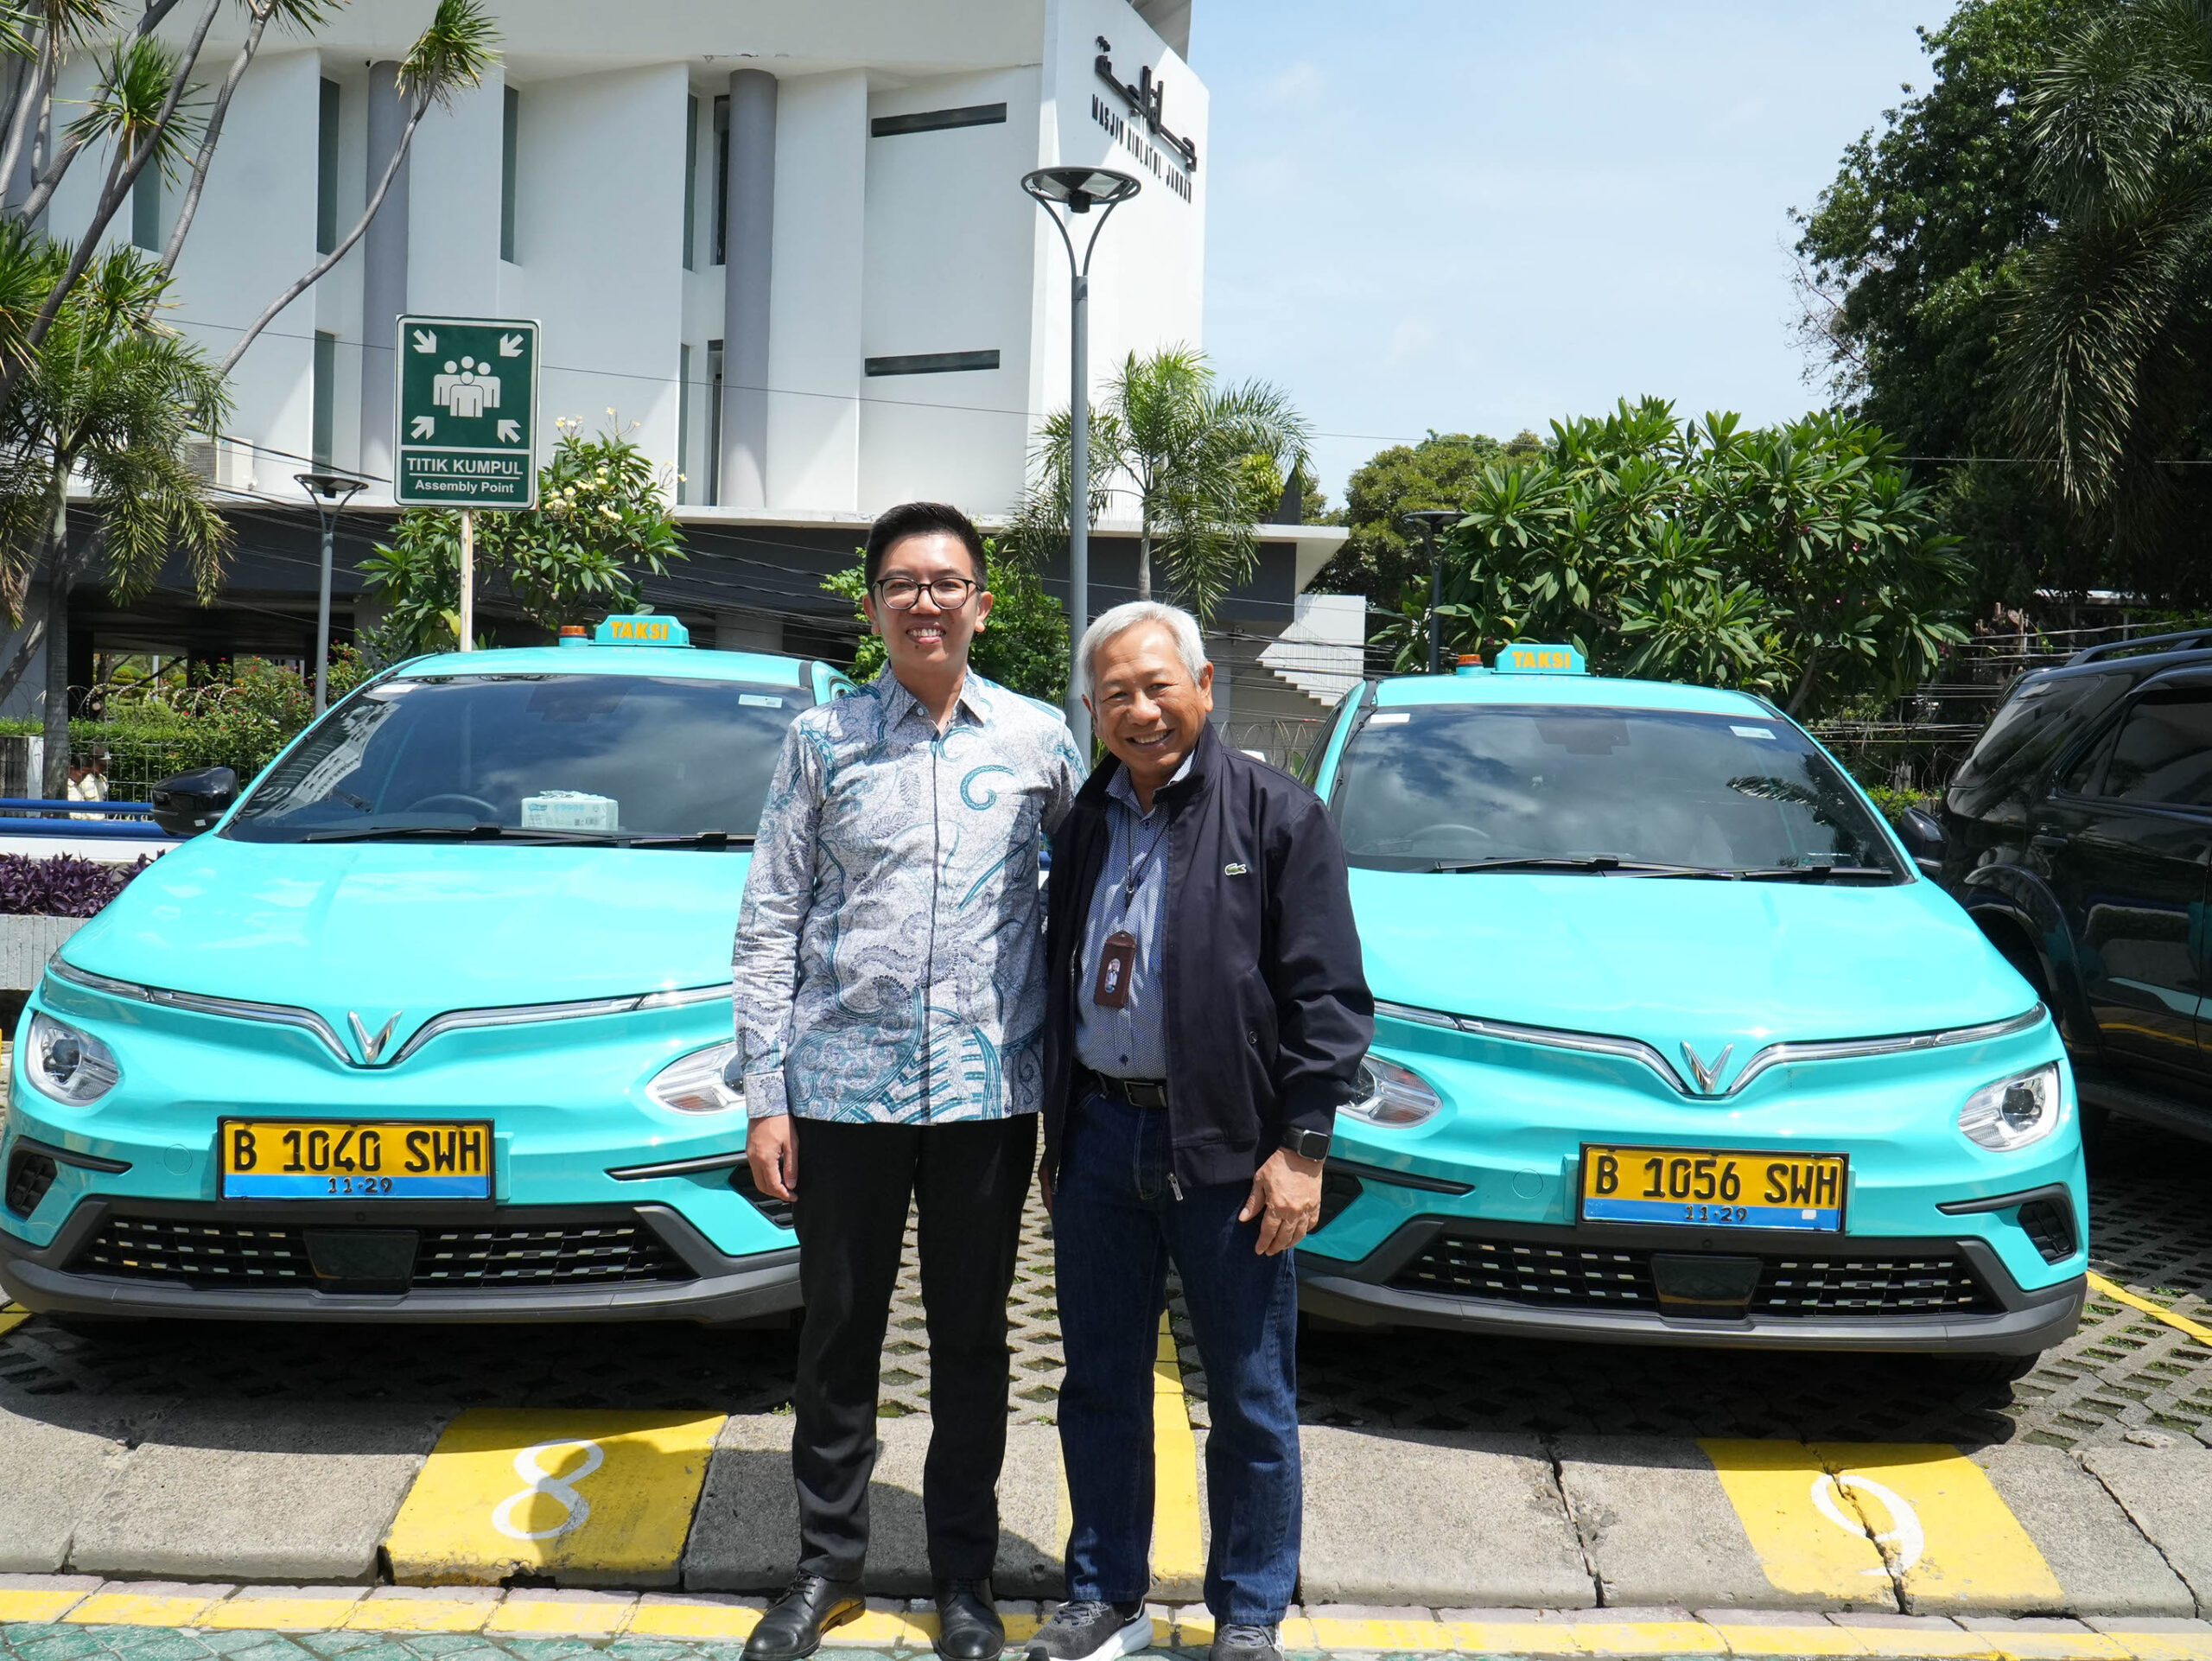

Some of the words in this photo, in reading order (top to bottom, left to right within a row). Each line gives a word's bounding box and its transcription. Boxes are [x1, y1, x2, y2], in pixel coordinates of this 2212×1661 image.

[407, 457, 448, 473] TITIK
[453, 459, 524, 475] KUMPUL
[415, 479, 477, 494] Assembly
[480, 481, 514, 493] Point
[609, 620, 669, 640] TAKSI
[1511, 651, 1571, 669] TAKSI
[234, 1129, 257, 1171] B
[283, 1129, 382, 1172] 1040
[404, 1130, 482, 1173] SWH
[1596, 1155, 1618, 1194] B
[1643, 1156, 1742, 1201] 1056
[1764, 1162, 1838, 1206] SWH
[492, 1438, 605, 1540] 8
[1810, 1474, 1925, 1575] 9
